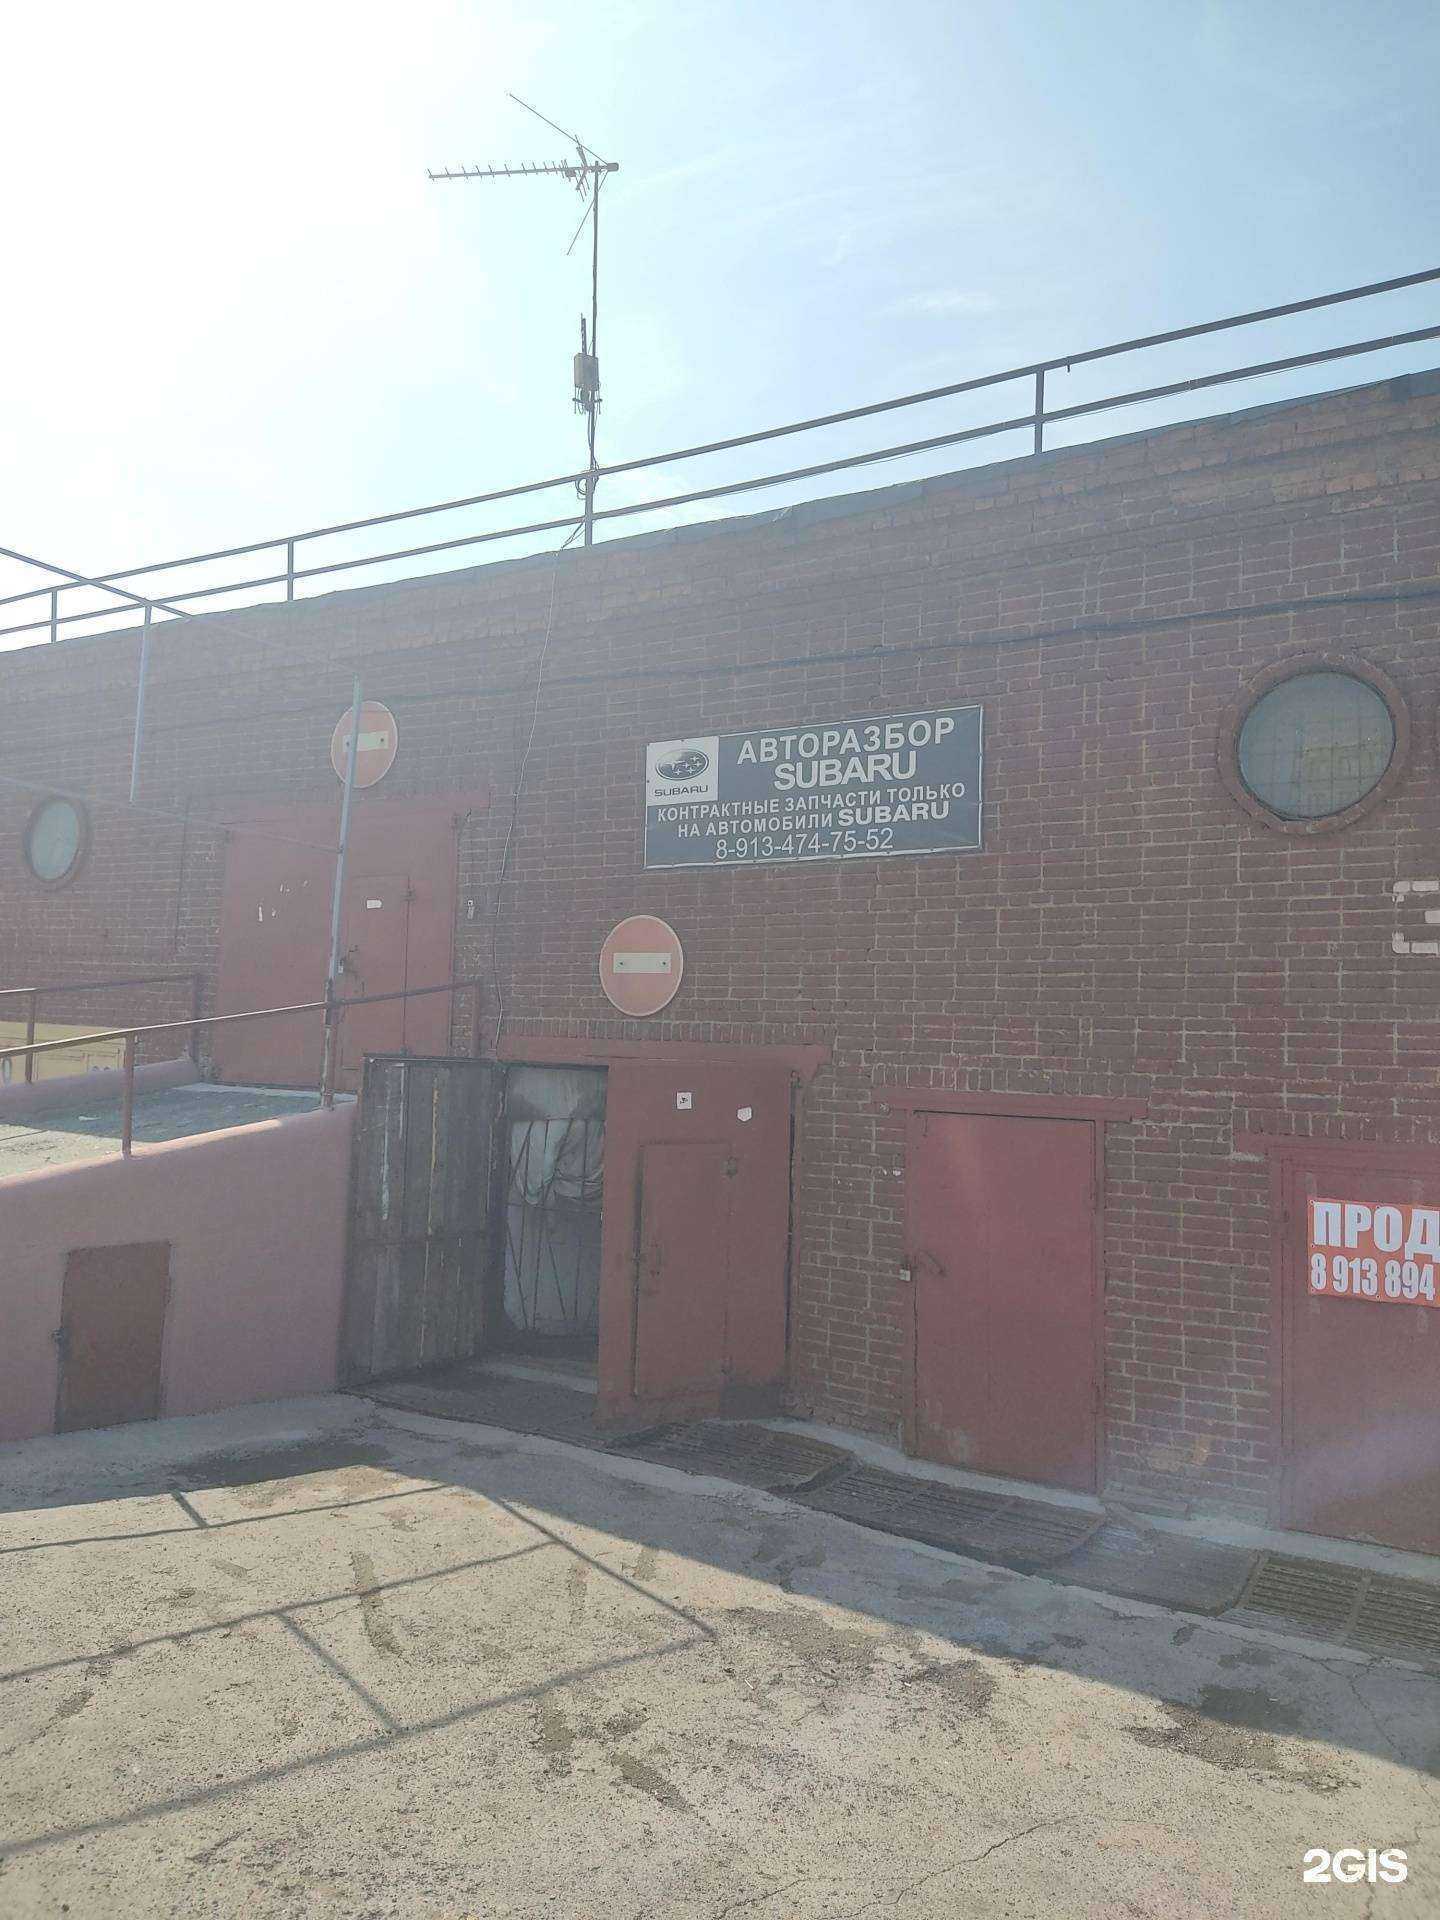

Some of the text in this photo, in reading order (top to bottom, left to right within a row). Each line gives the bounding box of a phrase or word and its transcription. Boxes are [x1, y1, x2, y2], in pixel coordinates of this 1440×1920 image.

[737, 717, 955, 765] АВТОРАЗБОР
[654, 784, 709, 797] SUBARU
[773, 750, 917, 791] SUBARU
[657, 782, 966, 823] КОНТРАКТНЫЕ ЗАПЧАСТИ ТОЛЬКО
[678, 801, 950, 838] НА АВТОМОБИЛИ SUBARU
[716, 827, 894, 860] 8-913-474-75-52
[1311, 1252, 1436, 1301] 8 913 894
